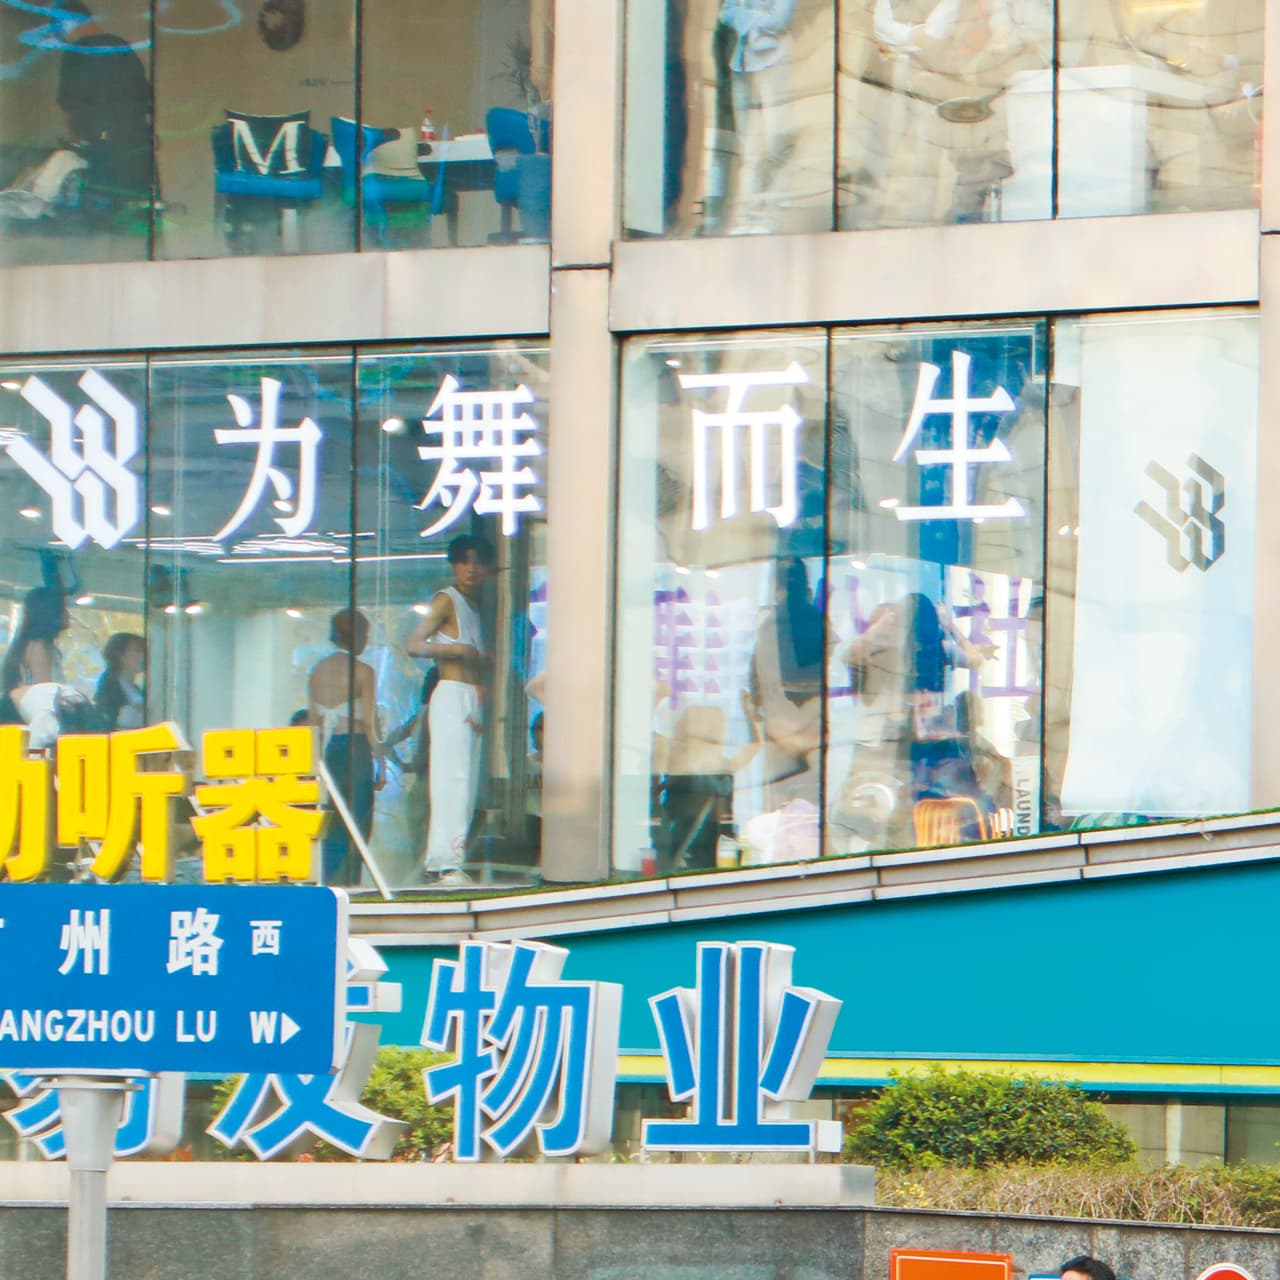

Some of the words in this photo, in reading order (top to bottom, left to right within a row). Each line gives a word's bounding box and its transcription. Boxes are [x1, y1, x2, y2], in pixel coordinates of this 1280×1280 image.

[227, 118, 307, 175] M
[213, 349, 1026, 542] 为舞而生
[0, 907, 224, 975] 州路
[176, 1010, 217, 1042] LU
[250, 1011, 278, 1044] W
